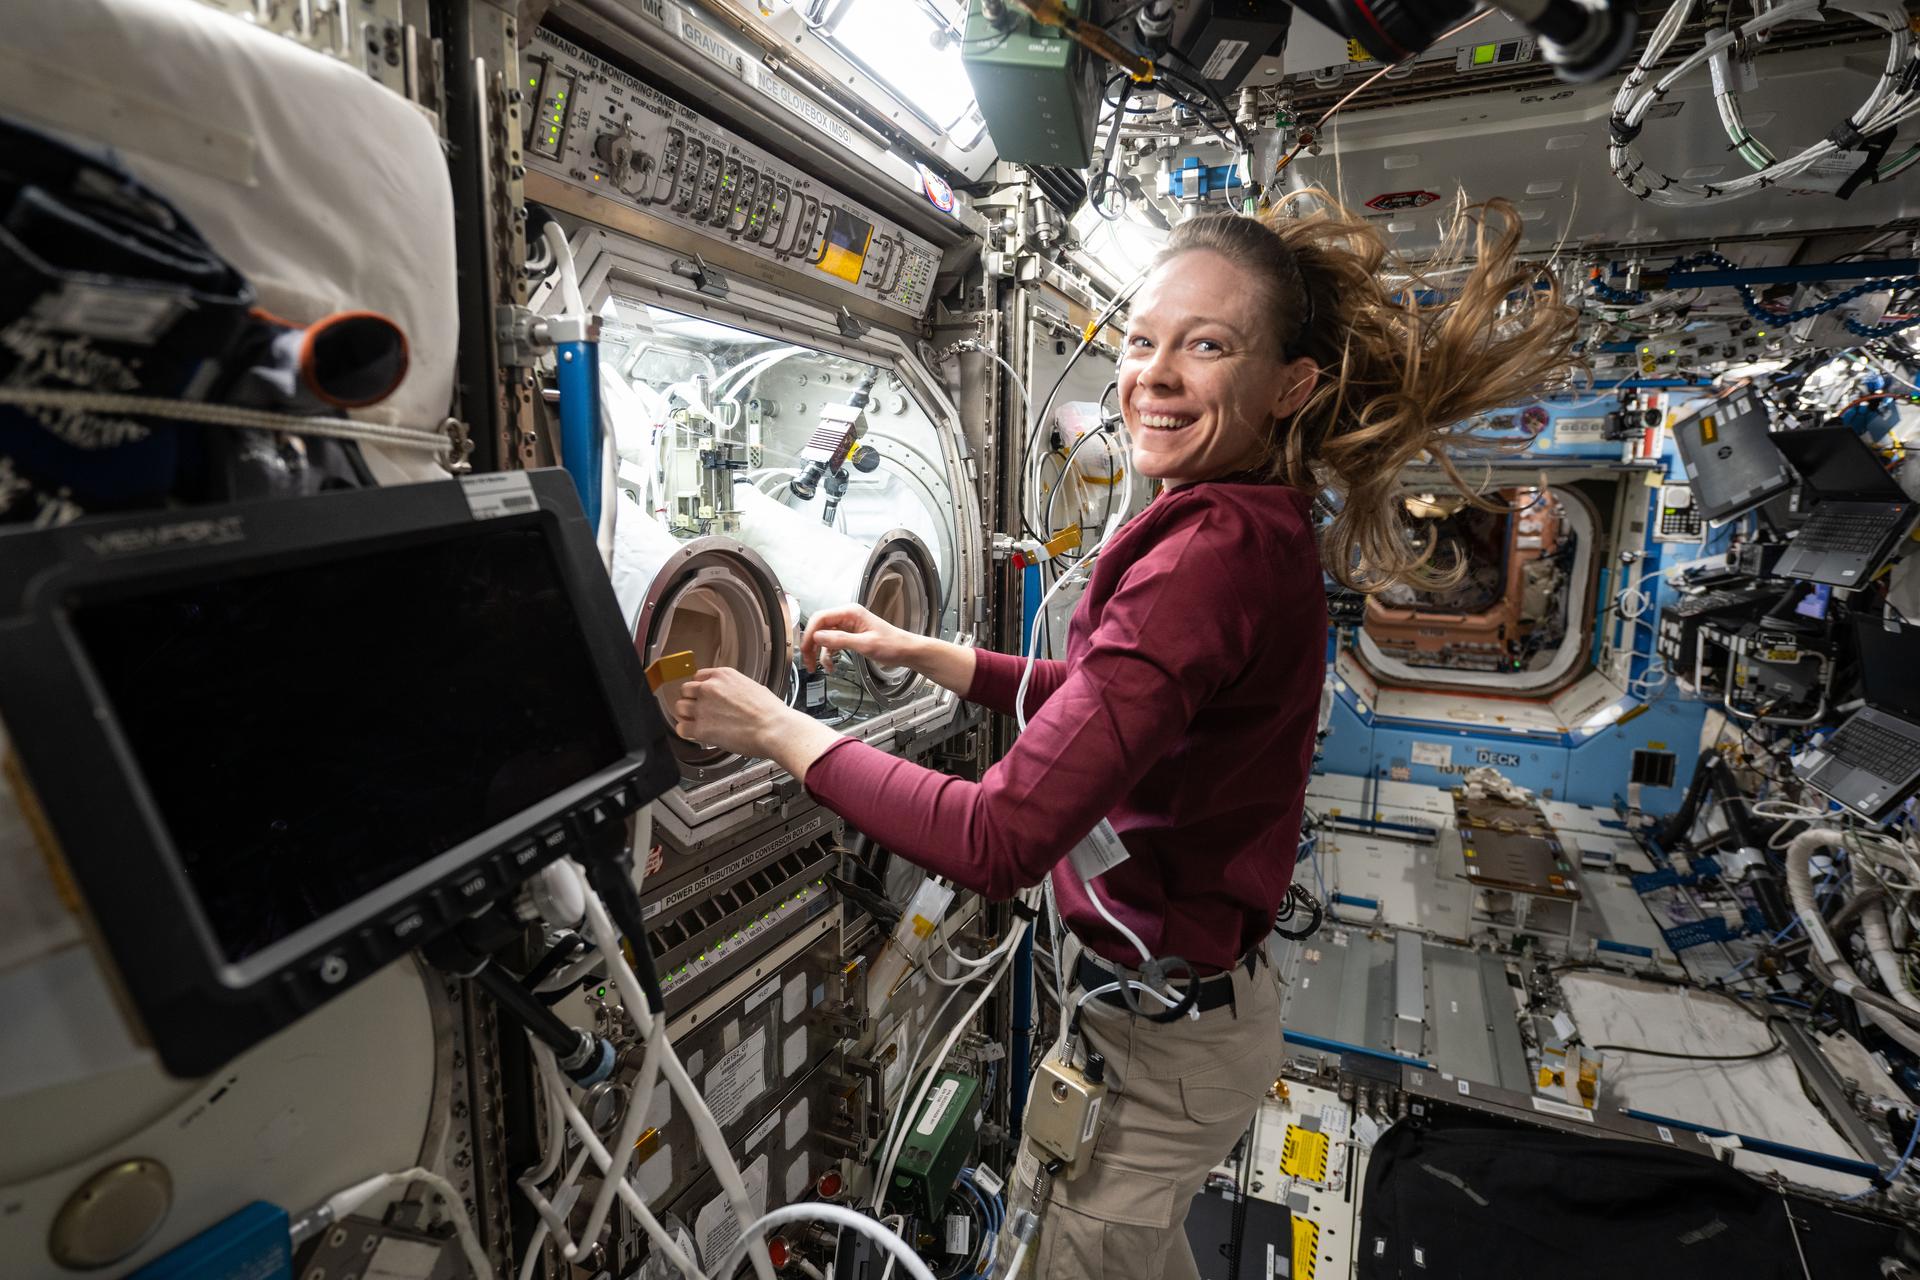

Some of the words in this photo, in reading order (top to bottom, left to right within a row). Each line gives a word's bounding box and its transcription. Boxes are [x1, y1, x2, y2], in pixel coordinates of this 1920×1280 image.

[535, 26, 578, 57] OMMAND
[579, 51, 599, 68] AND
[600, 61, 653, 98] MONITORING
[653, 91, 677, 113] PANEL
[677, 103, 699, 124] (CMP)
[611, 84, 624, 96] TEST
[643, 0, 732, 64] MICGRAVITY
[736, 56, 779, 96] SNCE
[781, 87, 828, 127] GLOVEBOX
[829, 120, 852, 144] (MSG)
[630, 95, 658, 114] INTERFACES
[1478, 751, 1519, 767] DECK
[665, 886, 693, 907] POWER
[694, 862, 741, 892] DISTRIBUTION
[741, 854, 755, 868] AND
[754, 832, 792, 859] CONVERSION
[792, 826, 804, 839] BOX
[804, 819, 819, 832] (PDC)
